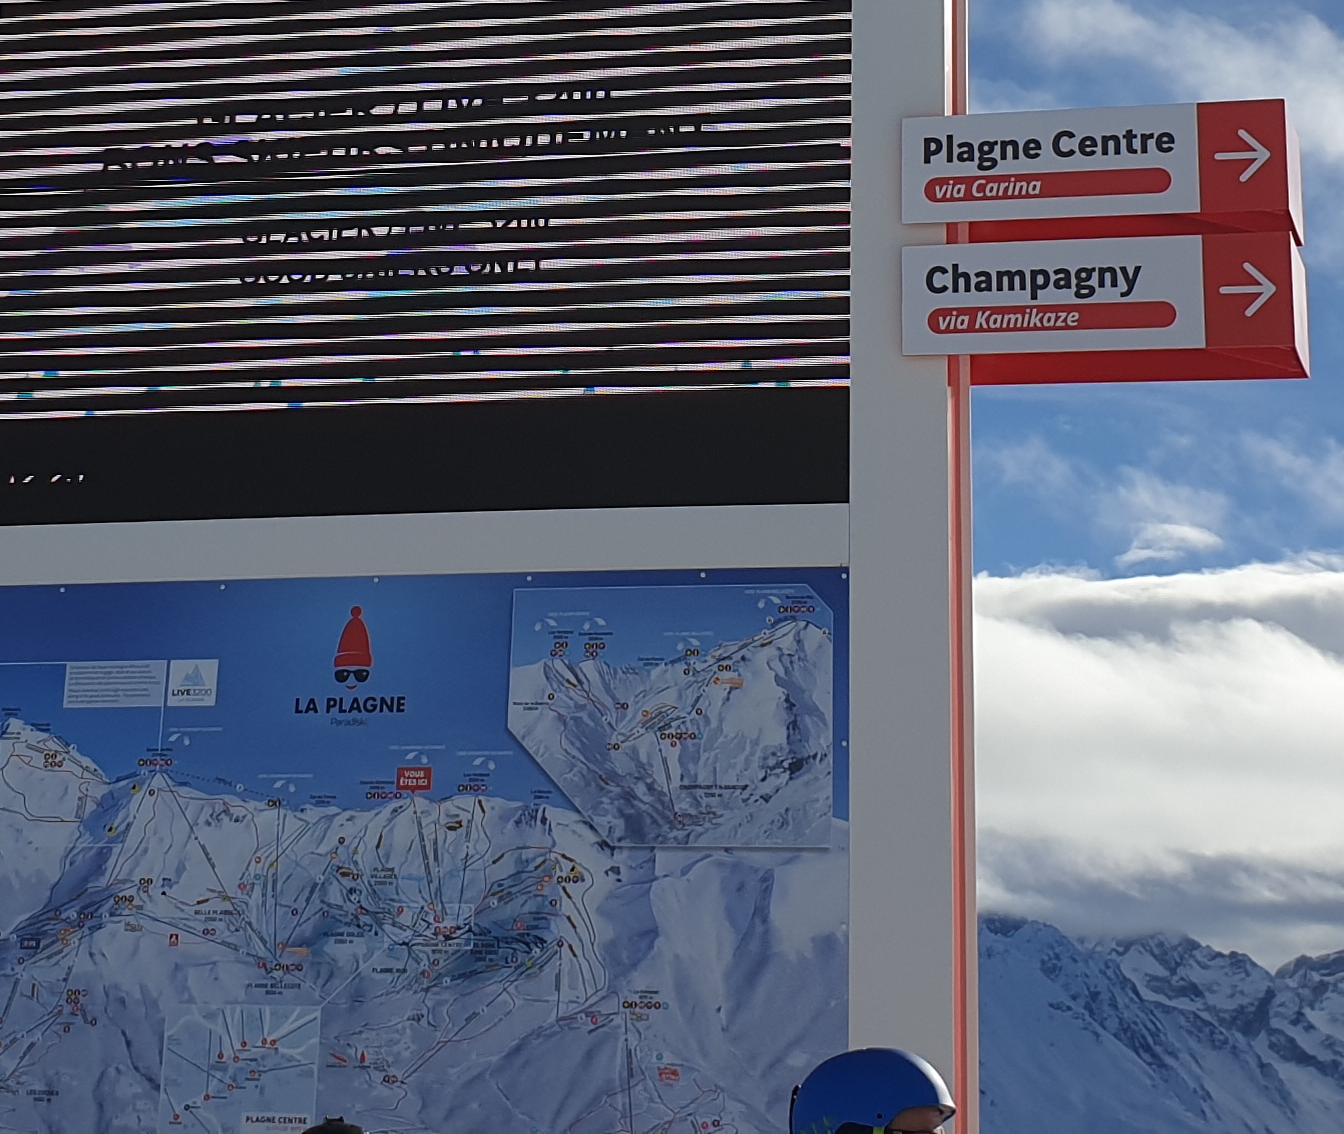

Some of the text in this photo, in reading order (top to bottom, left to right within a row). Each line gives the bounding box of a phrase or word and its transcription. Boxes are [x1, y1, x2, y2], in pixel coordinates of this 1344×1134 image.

[923, 128, 1175, 171] Plagne Centre
[934, 177, 1042, 199] via Carina
[925, 263, 1142, 300] Champagny
[938, 308, 1080, 330] via Kamikaze
[294, 696, 406, 714] LA PLAGNE
[404, 770, 425, 778] VOUS
[245, 1115, 308, 1125] PLAGNE CENTRE
